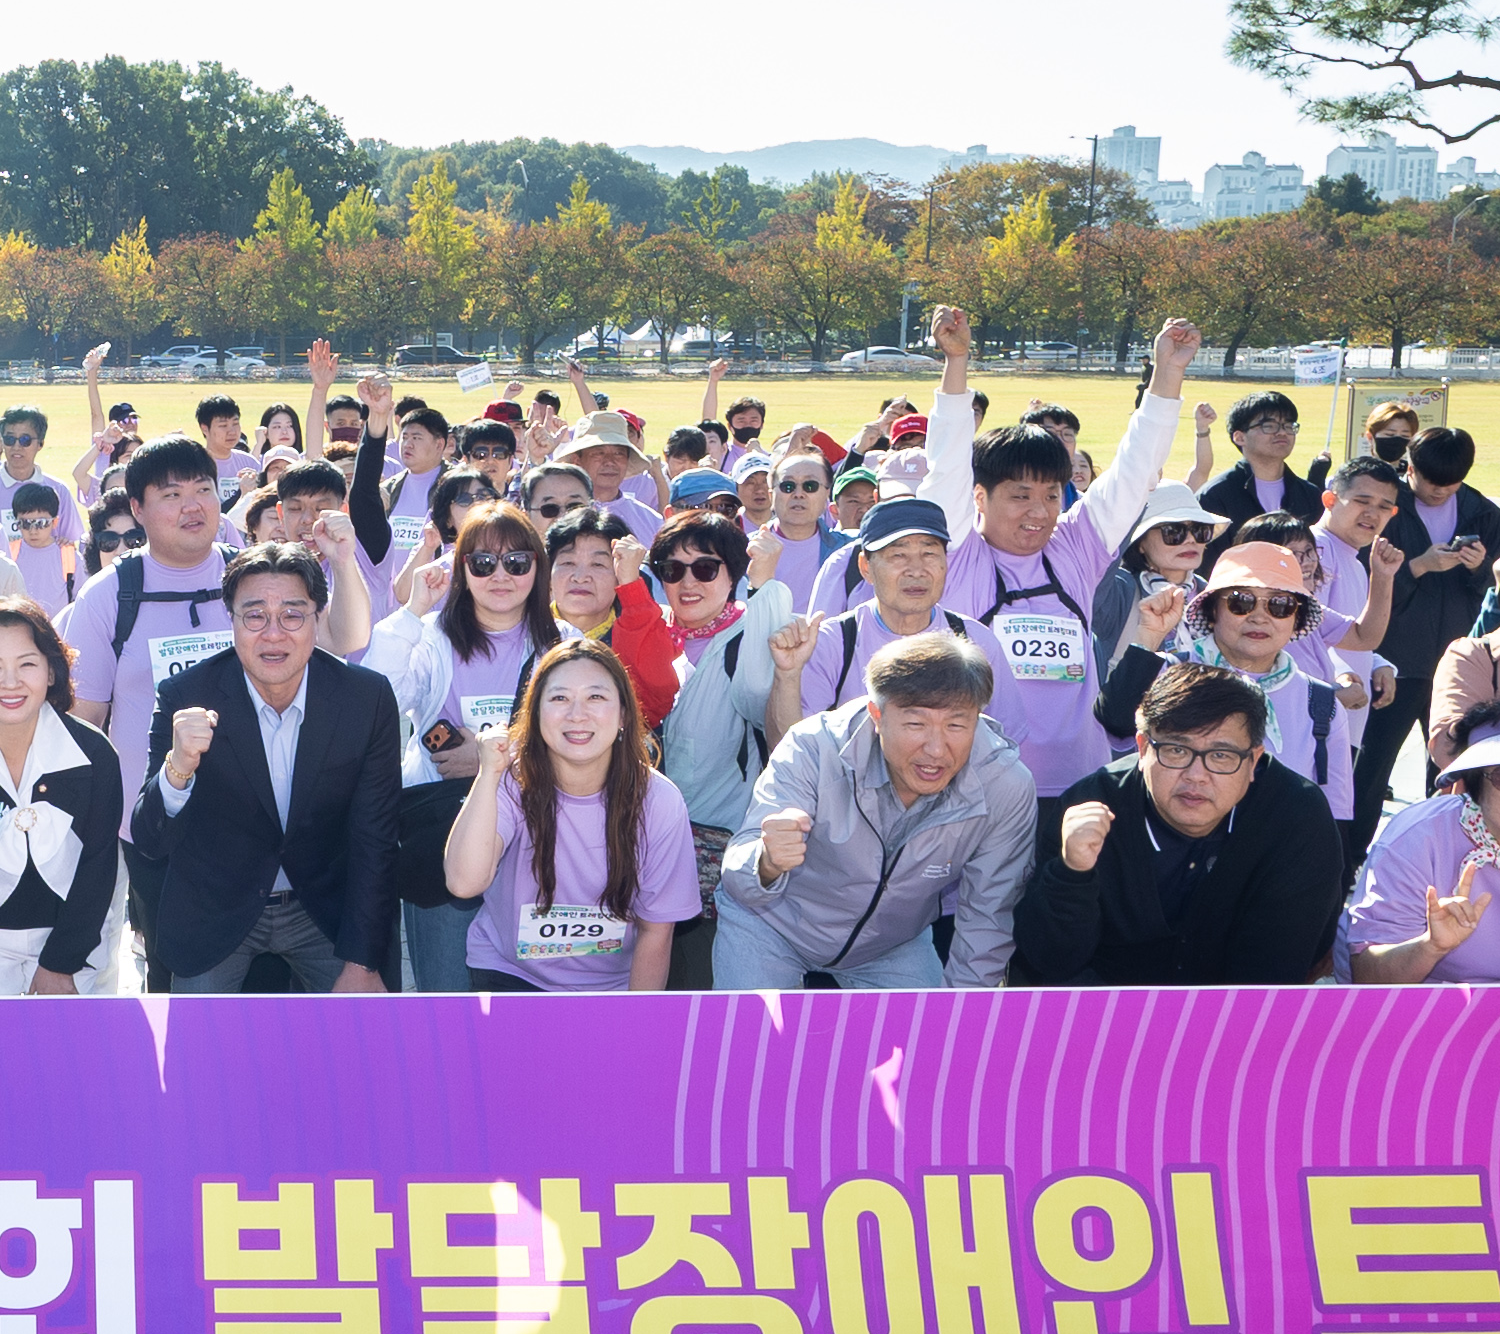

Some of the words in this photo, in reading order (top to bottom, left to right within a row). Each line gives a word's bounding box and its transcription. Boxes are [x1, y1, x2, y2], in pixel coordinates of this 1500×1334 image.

[394, 529, 420, 540] 0215
[1003, 624, 1046, 635] 발달장애인
[158, 643, 199, 658] 발달장애인
[1011, 639, 1071, 659] 0236
[539, 923, 604, 938] 0129
